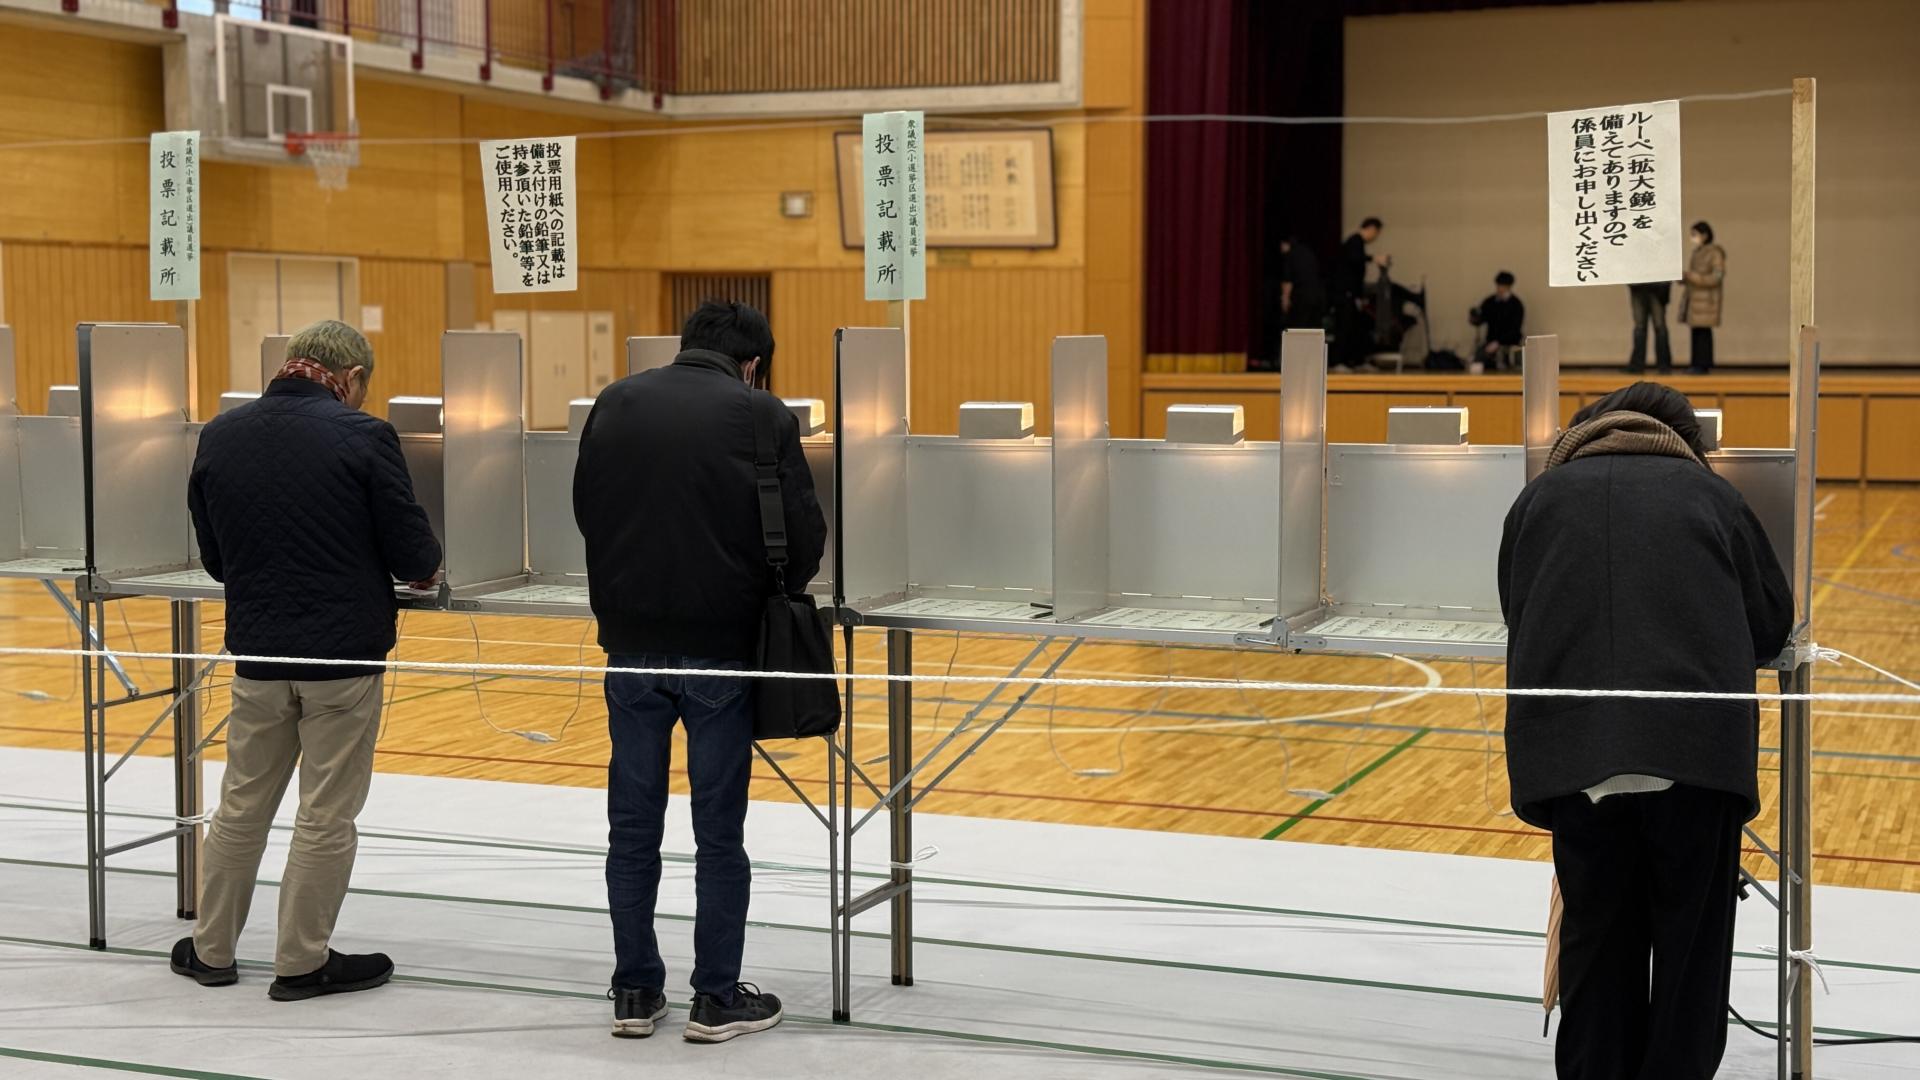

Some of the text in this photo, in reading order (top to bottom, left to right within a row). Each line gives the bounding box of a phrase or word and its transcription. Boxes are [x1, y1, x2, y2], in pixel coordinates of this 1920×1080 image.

[159, 150, 177, 286] 投票記載所
[495, 145, 519, 259] ご使用ください。
[512, 144, 535, 287] 持参頂いた鉛筆等を
[530, 143, 551, 285] 備え付けの鉛筆又は
[546, 142, 566, 278] 投票用紙への記載は
[874, 133, 898, 285] 投票記載所
[1571, 117, 1599, 282] 係員にお申し出ください
[1599, 113, 1629, 247] 備えてありますので
[1627, 110, 1657, 230] ルーペ（拡大鏡）を
